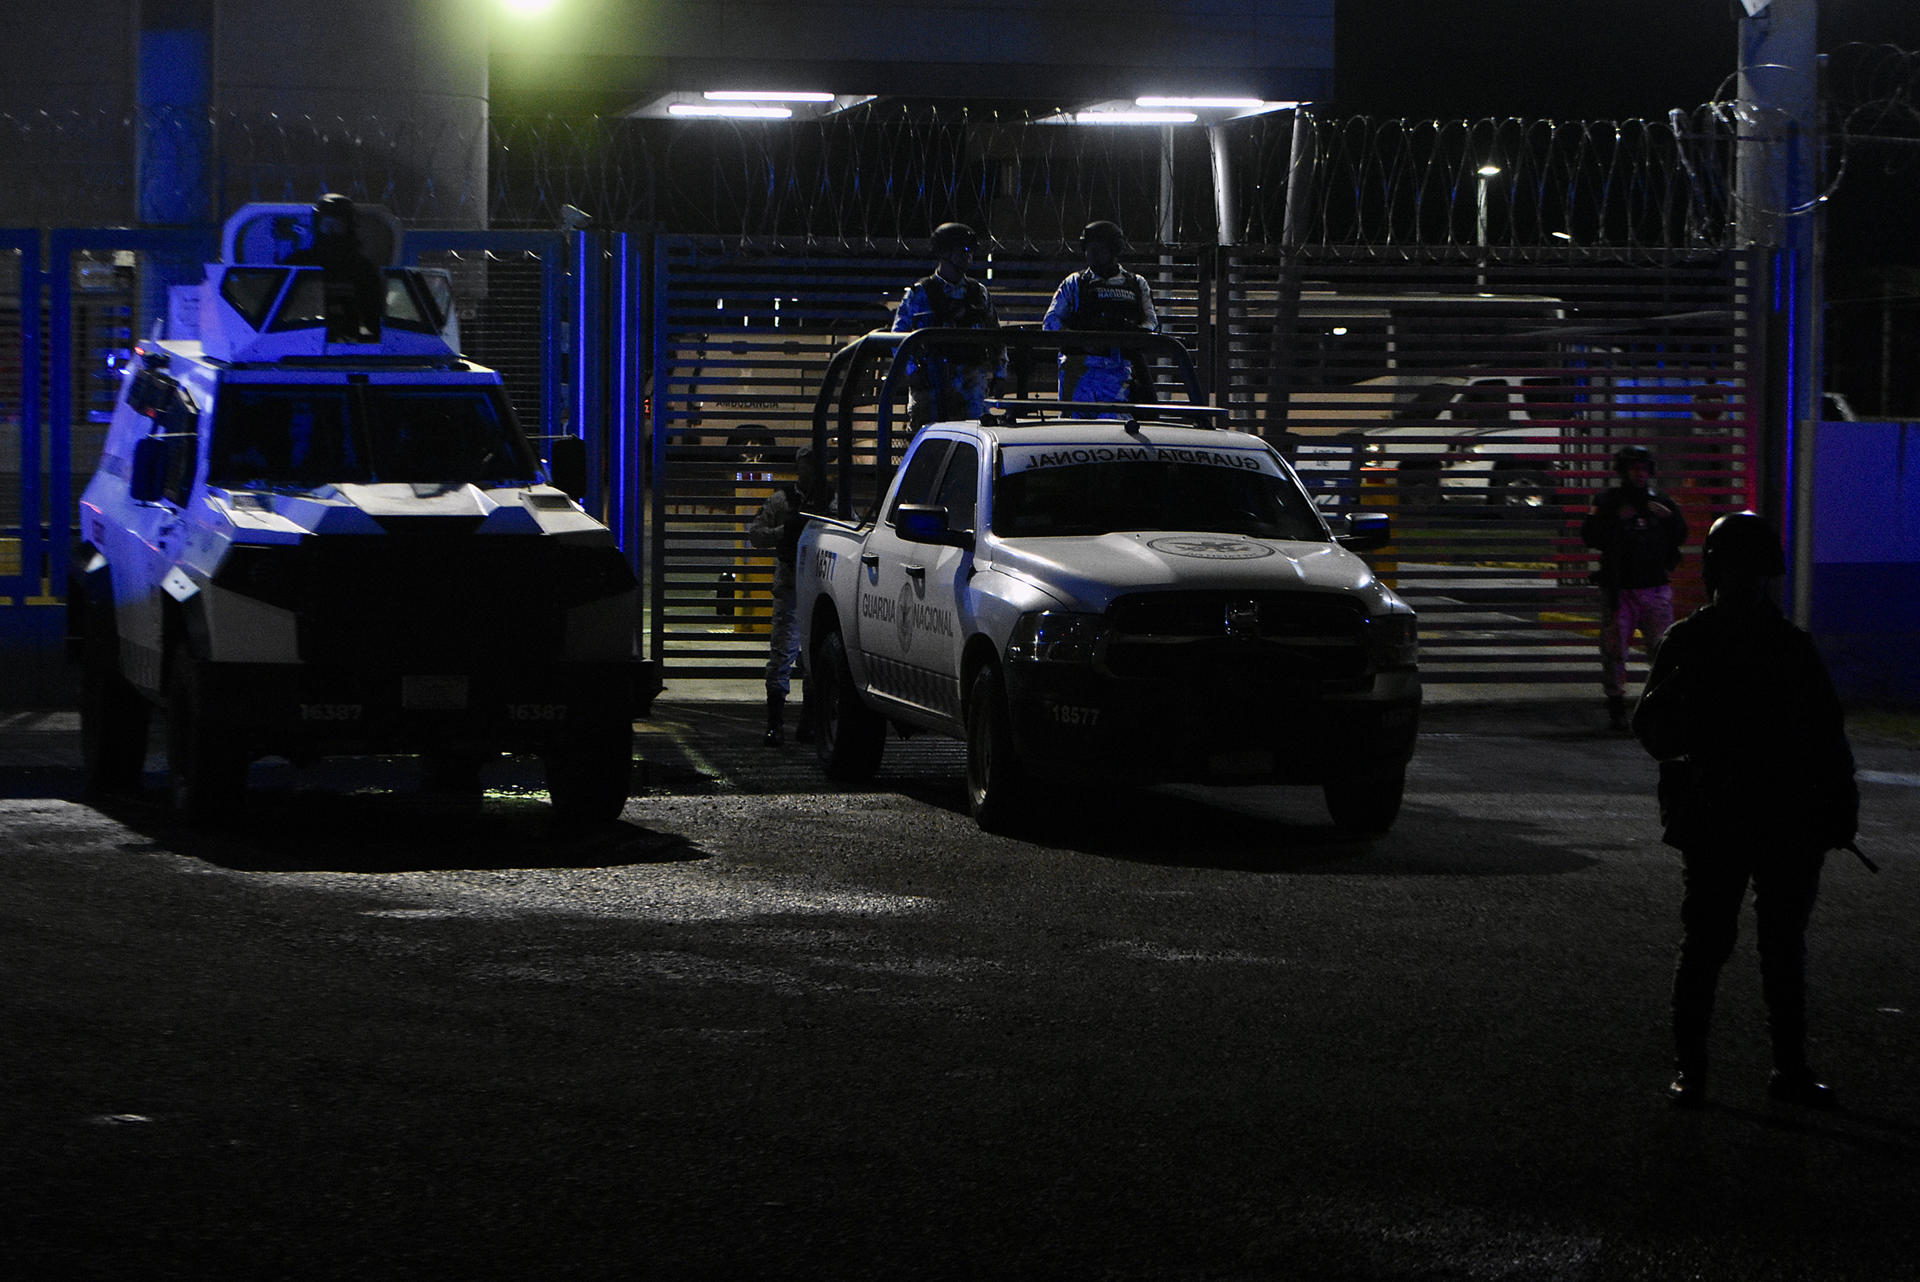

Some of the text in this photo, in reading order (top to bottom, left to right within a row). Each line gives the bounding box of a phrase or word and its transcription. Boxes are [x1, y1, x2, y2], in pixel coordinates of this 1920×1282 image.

[862, 593, 954, 638] GUARDIA NACIONAL
[1051, 704, 1101, 725] 18577
